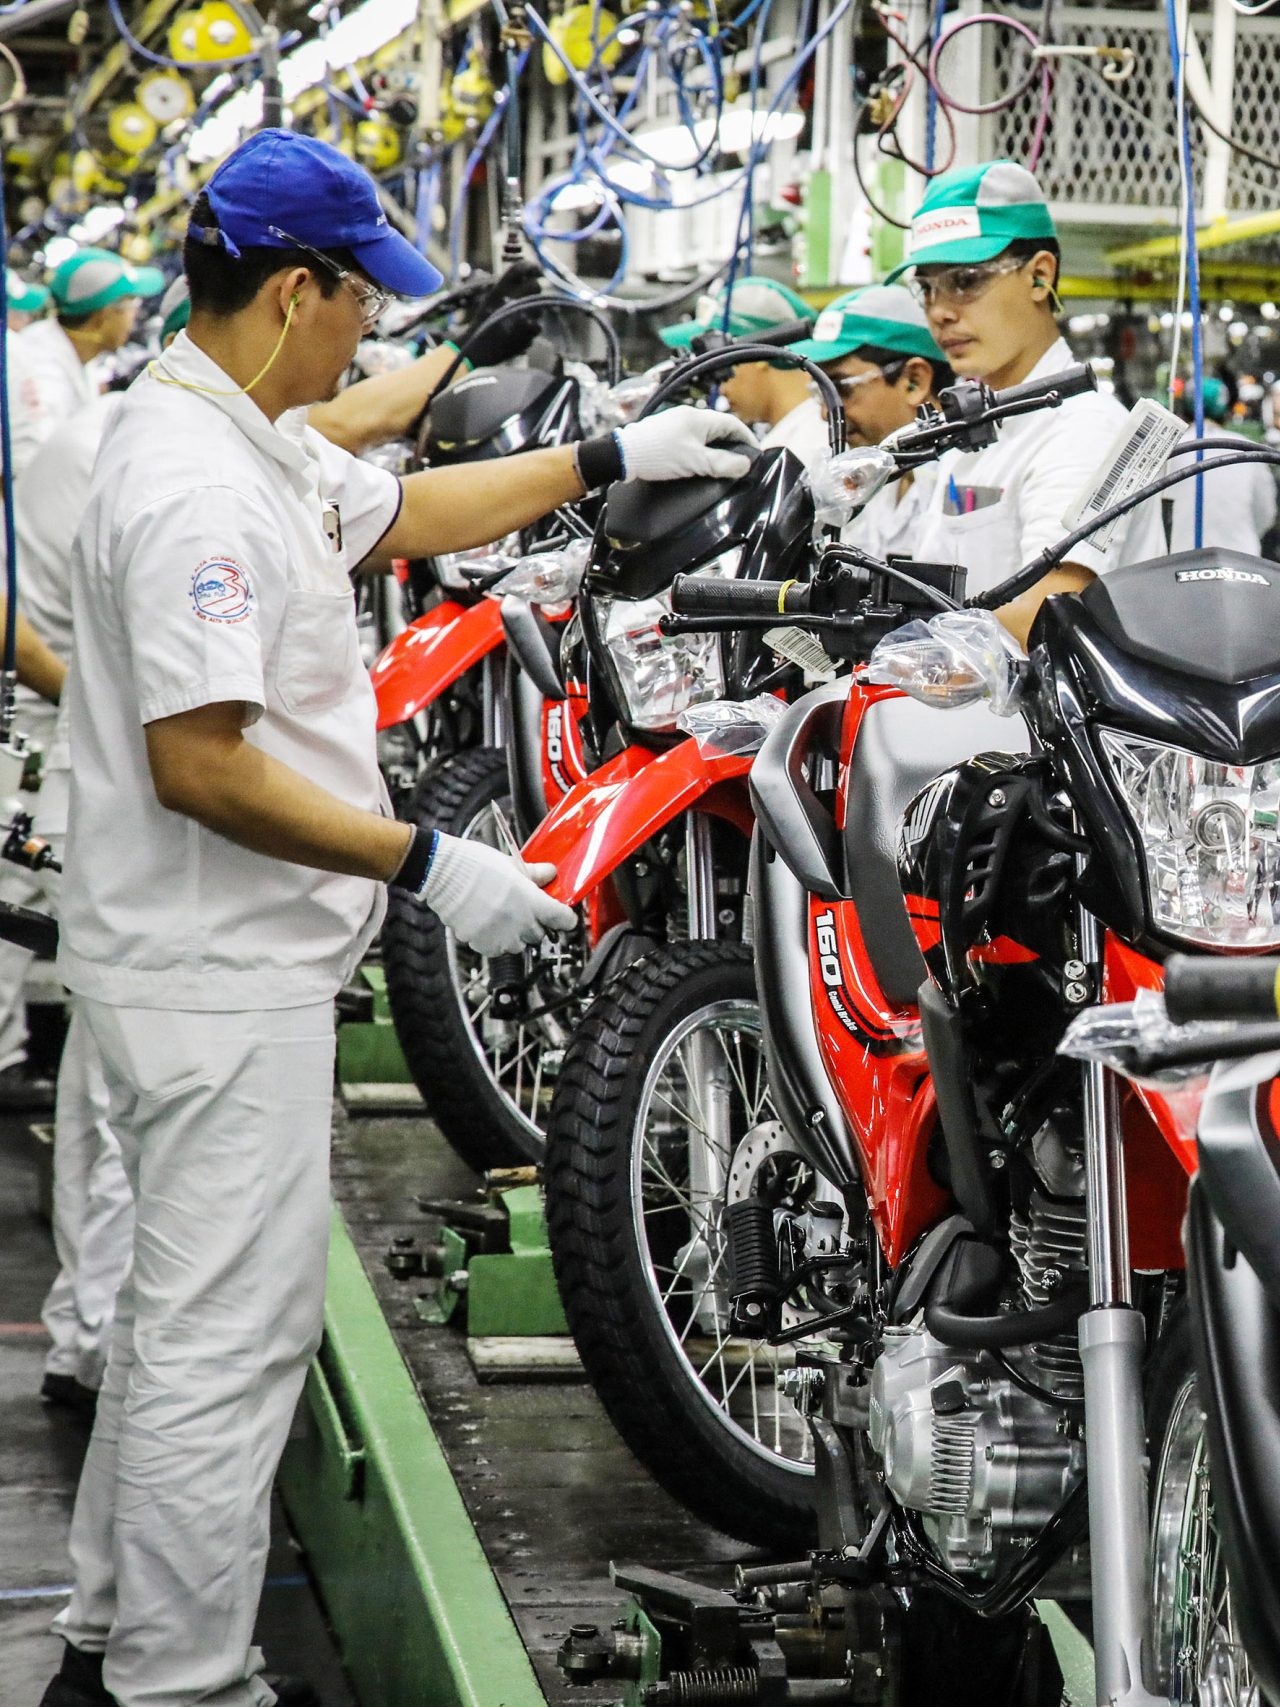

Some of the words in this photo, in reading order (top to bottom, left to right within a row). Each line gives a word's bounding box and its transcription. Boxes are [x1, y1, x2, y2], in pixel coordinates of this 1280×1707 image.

[1177, 566, 1272, 586] HONDA
[547, 704, 562, 761] 160
[816, 908, 843, 986] 160
[828, 990, 843, 1013] Combi
[841, 1008, 858, 1031] Brake
